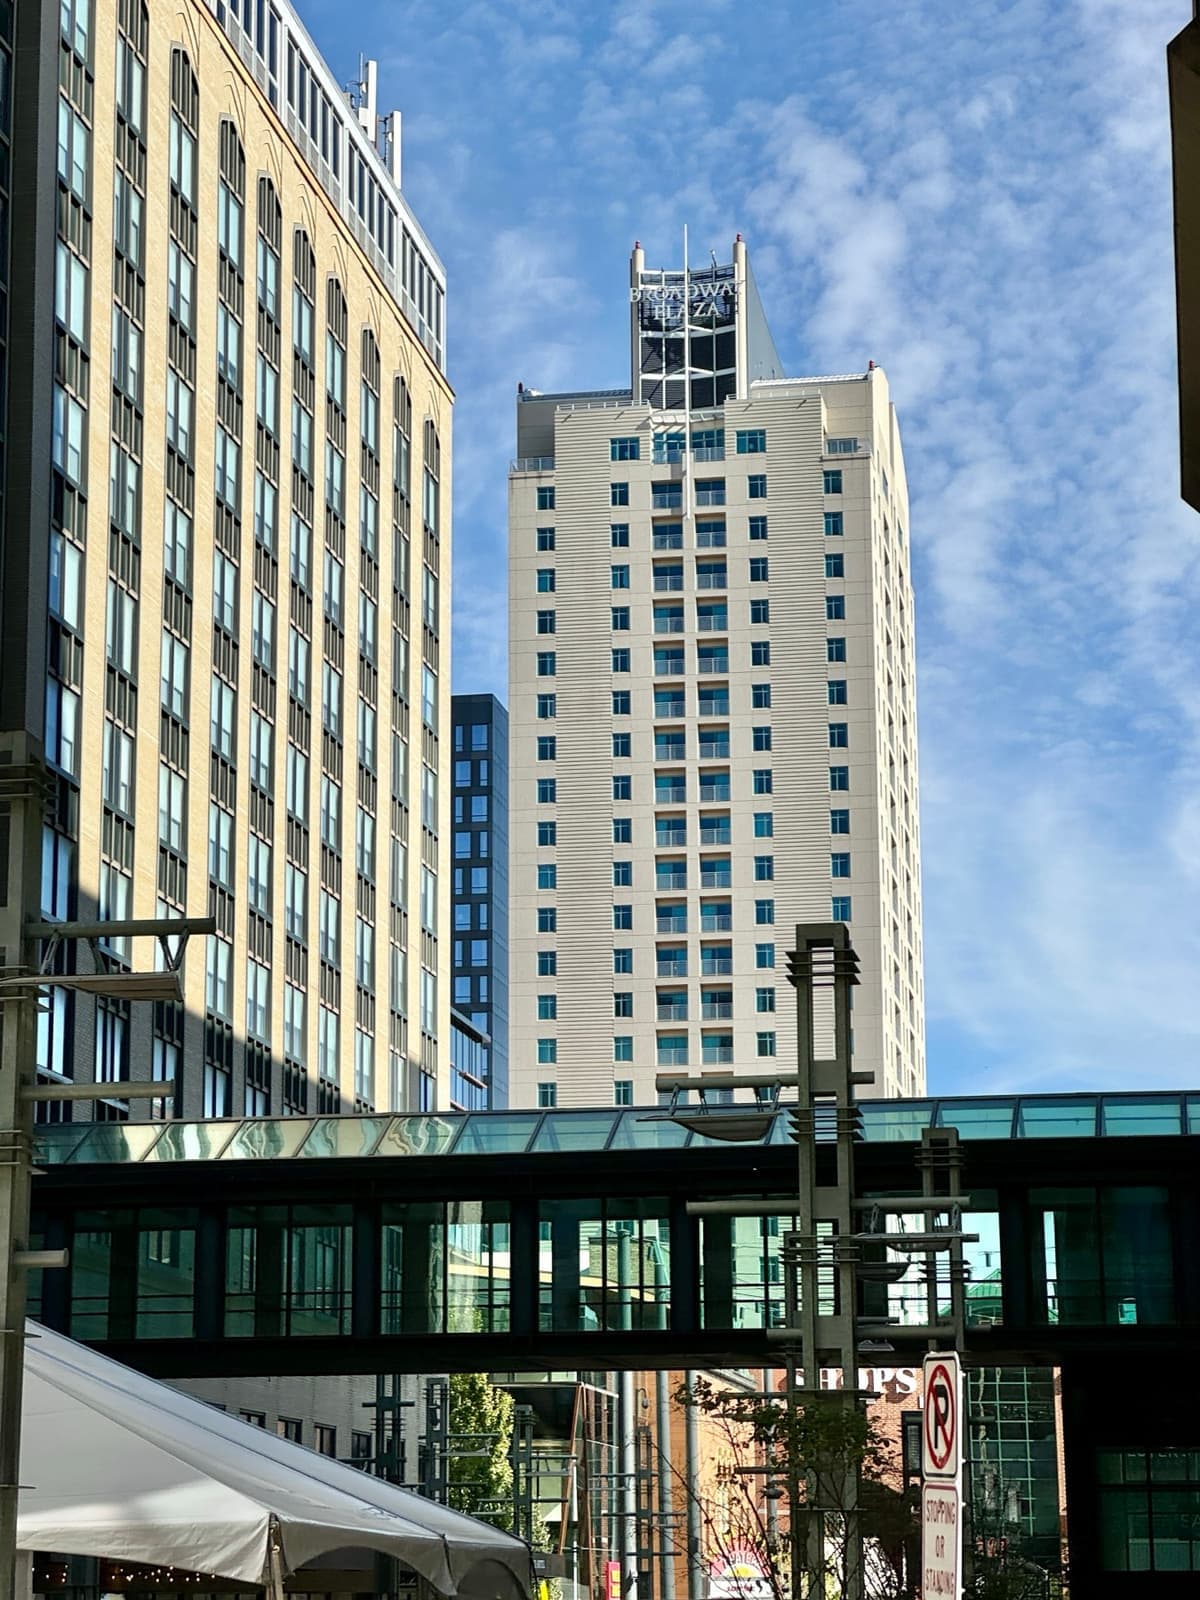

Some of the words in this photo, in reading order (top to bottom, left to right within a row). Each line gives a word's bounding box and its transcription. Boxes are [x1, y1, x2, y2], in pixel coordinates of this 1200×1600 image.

[654, 302, 721, 321] PLAZA
[926, 1499, 956, 1525] STOPPING
[936, 1535, 945, 1560] OR
[925, 1567, 955, 1597] STANDING
